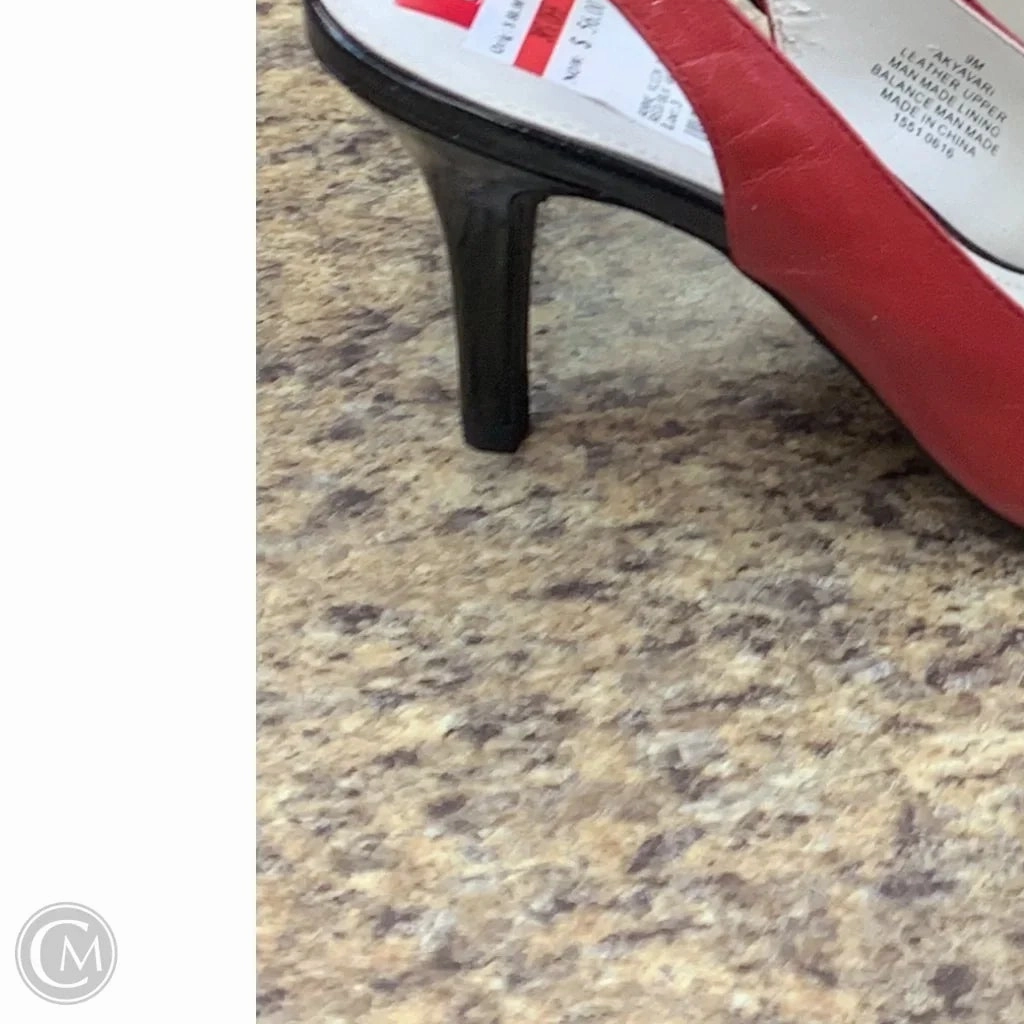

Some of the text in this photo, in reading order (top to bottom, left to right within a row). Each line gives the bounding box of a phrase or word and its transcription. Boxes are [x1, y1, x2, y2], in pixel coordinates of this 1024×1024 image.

[888, 56, 1001, 138] MAN MADE LINING
[900, 47, 1008, 124] LEATHER UPPER
[964, 54, 986, 72] 9M
[870, 63, 1001, 157] BALANCE MAN MADE
[879, 87, 978, 158] MADE IN CHINA
